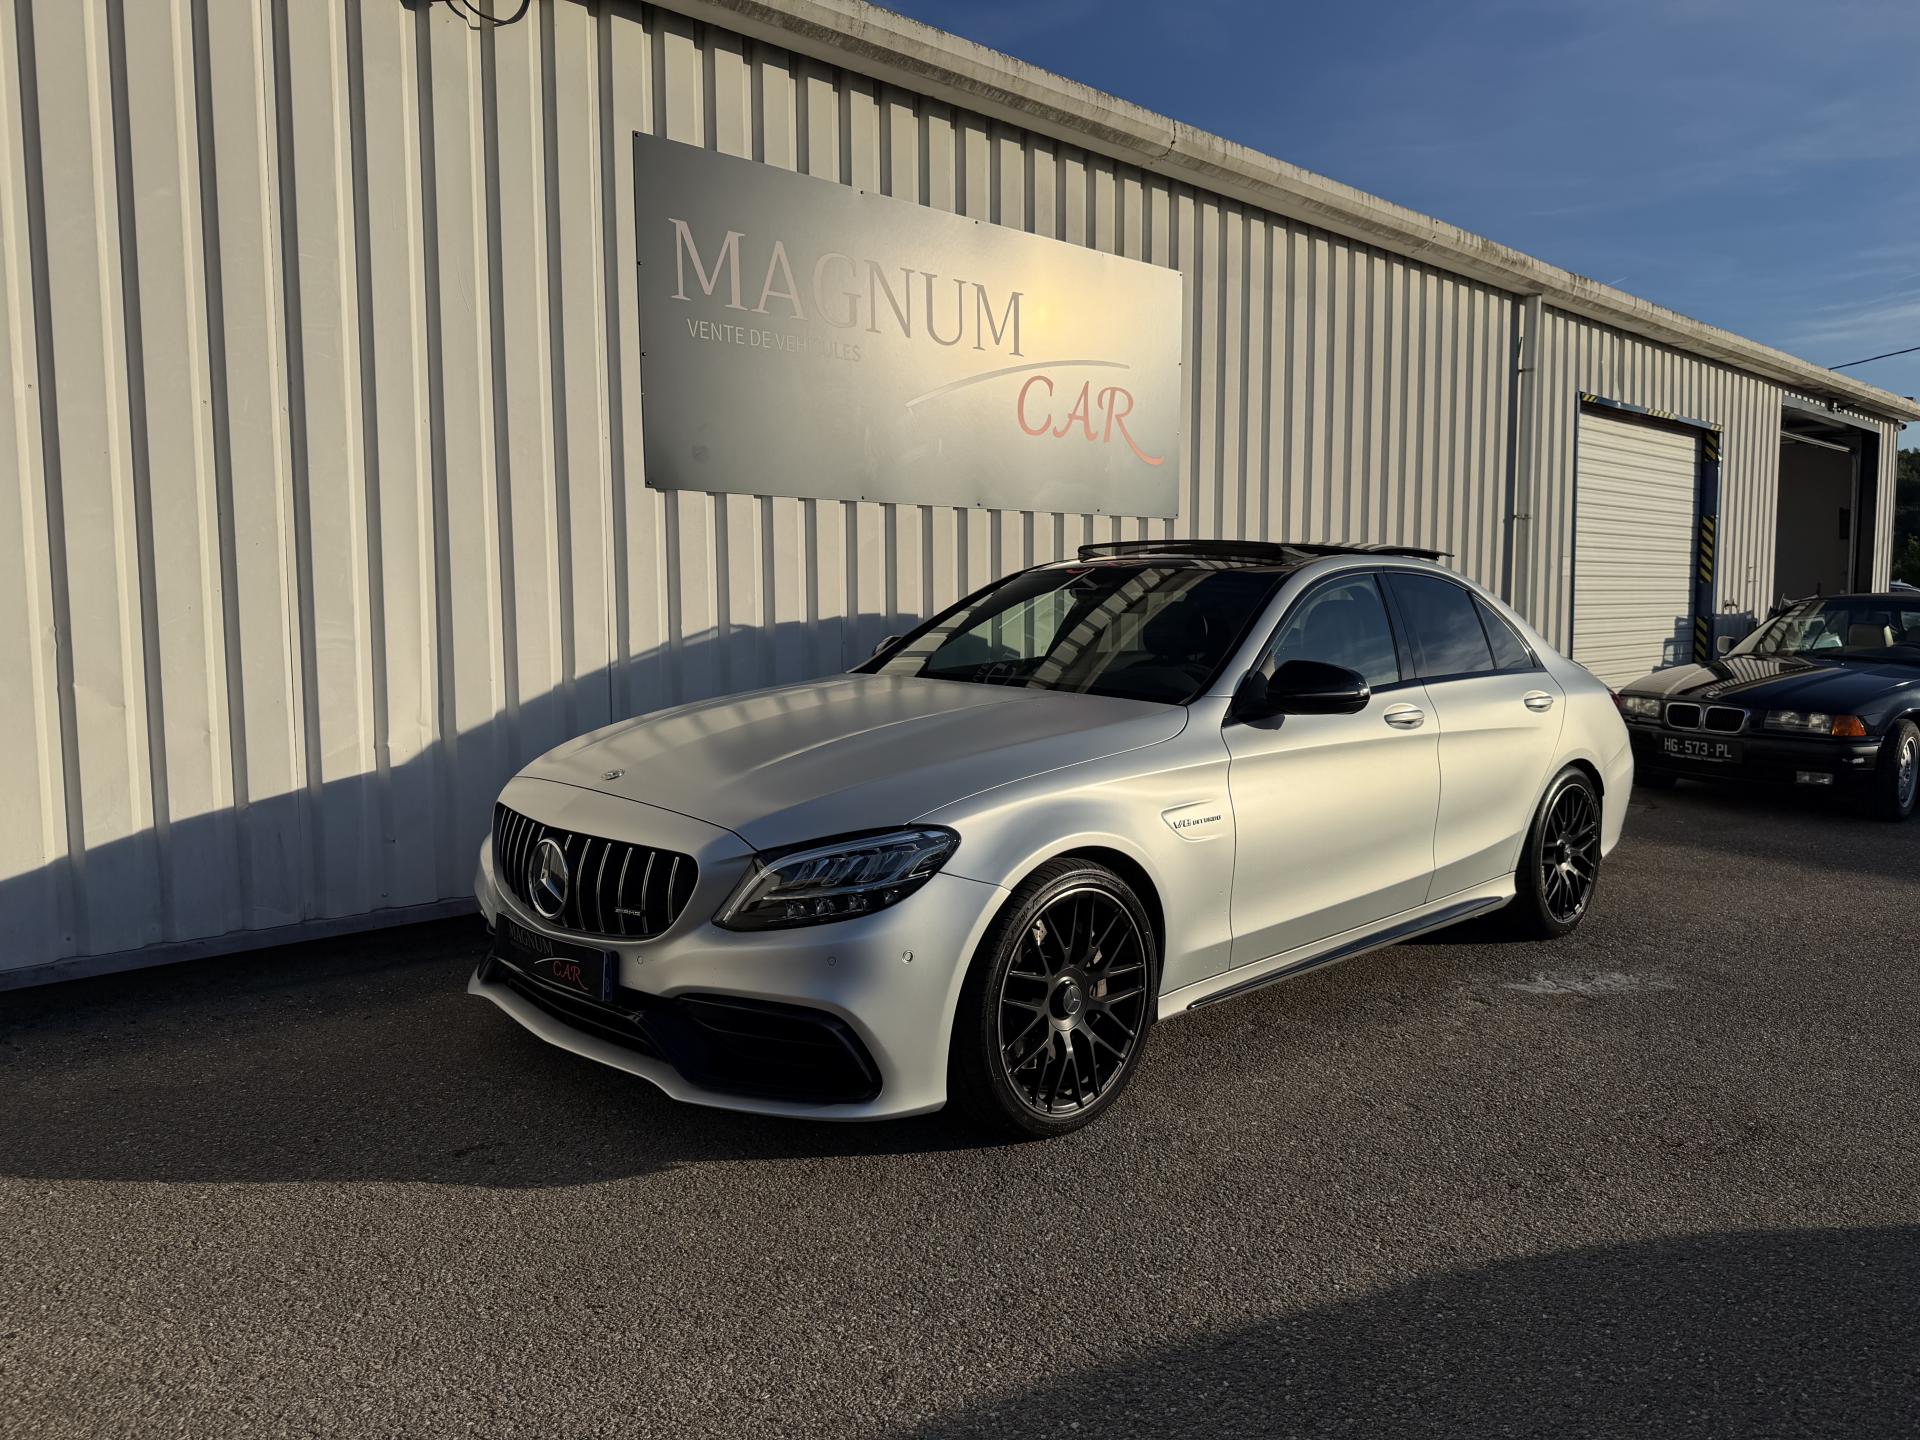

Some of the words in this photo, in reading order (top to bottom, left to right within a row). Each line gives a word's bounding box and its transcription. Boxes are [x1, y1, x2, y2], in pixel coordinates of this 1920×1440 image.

[667, 217, 1025, 357] MAGNUM
[687, 318, 745, 345] VENTE
[750, 328, 771, 349] DE
[1017, 375, 1164, 466] CAR
[1663, 737, 1733, 758] HG-573-PL
[508, 921, 555, 957] MAGNUM
[552, 960, 590, 991] CAR
